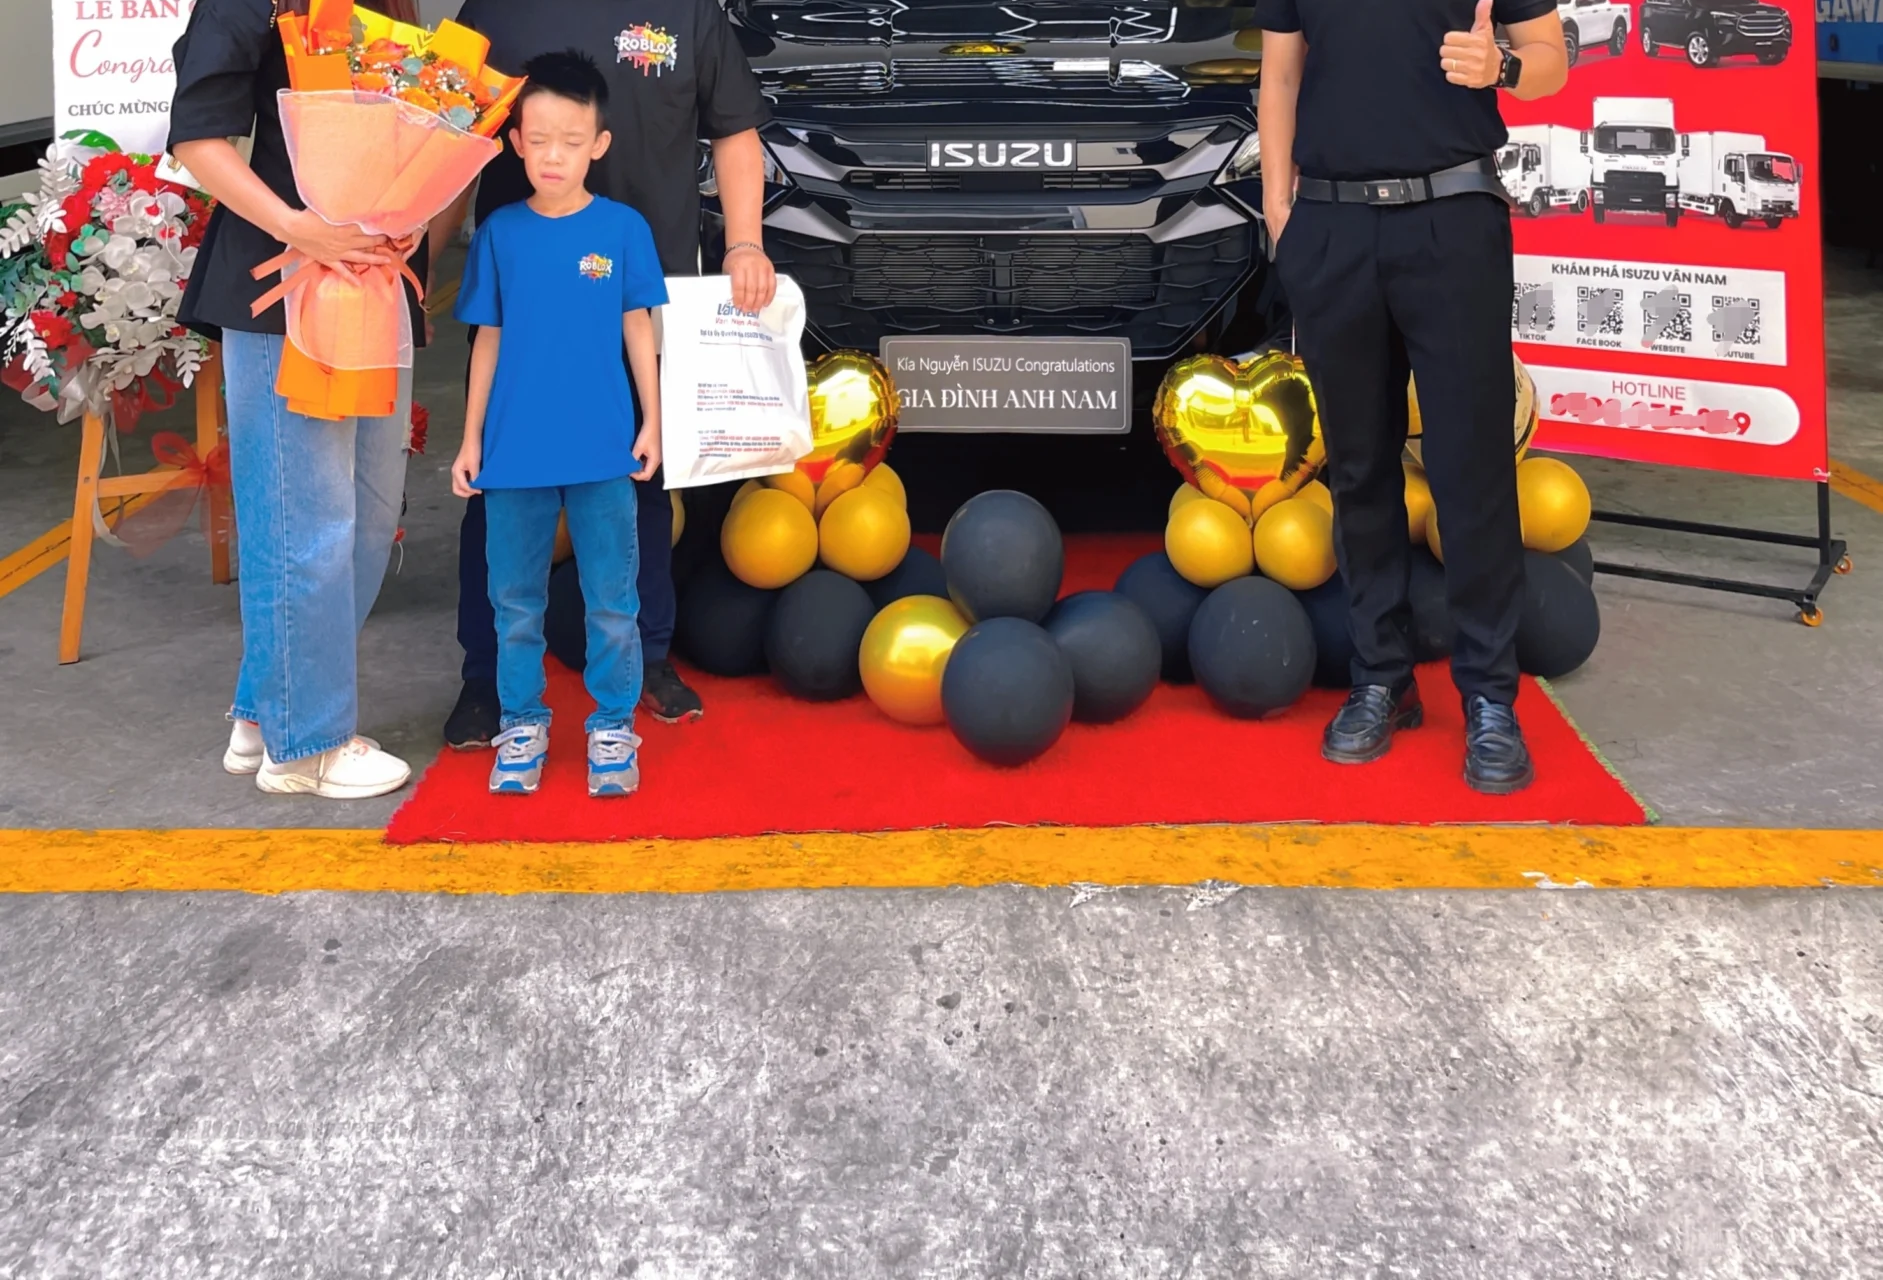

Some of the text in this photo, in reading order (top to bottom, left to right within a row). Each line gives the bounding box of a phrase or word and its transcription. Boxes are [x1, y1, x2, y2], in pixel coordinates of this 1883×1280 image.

[618, 36, 677, 60] ROBLOX
[68, 98, 170, 116] CHÚC MỪNG
[930, 142, 1073, 168] ISUZU
[579, 260, 613, 274] ROBLOX
[1551, 262, 1728, 286] KHÁM PHÁ ISUZU VÂN NAM
[1576, 337, 1623, 349] FACE BOOK
[1650, 343, 1686, 354] WEBSITE
[919, 354, 969, 376] Nguyễn
[972, 357, 1012, 373] ISUZU
[1015, 357, 1115, 376] Congratulations
[896, 382, 1118, 410] GIA ĐÌNH ANH NAM
[1611, 380, 1687, 402] HOTLINE
